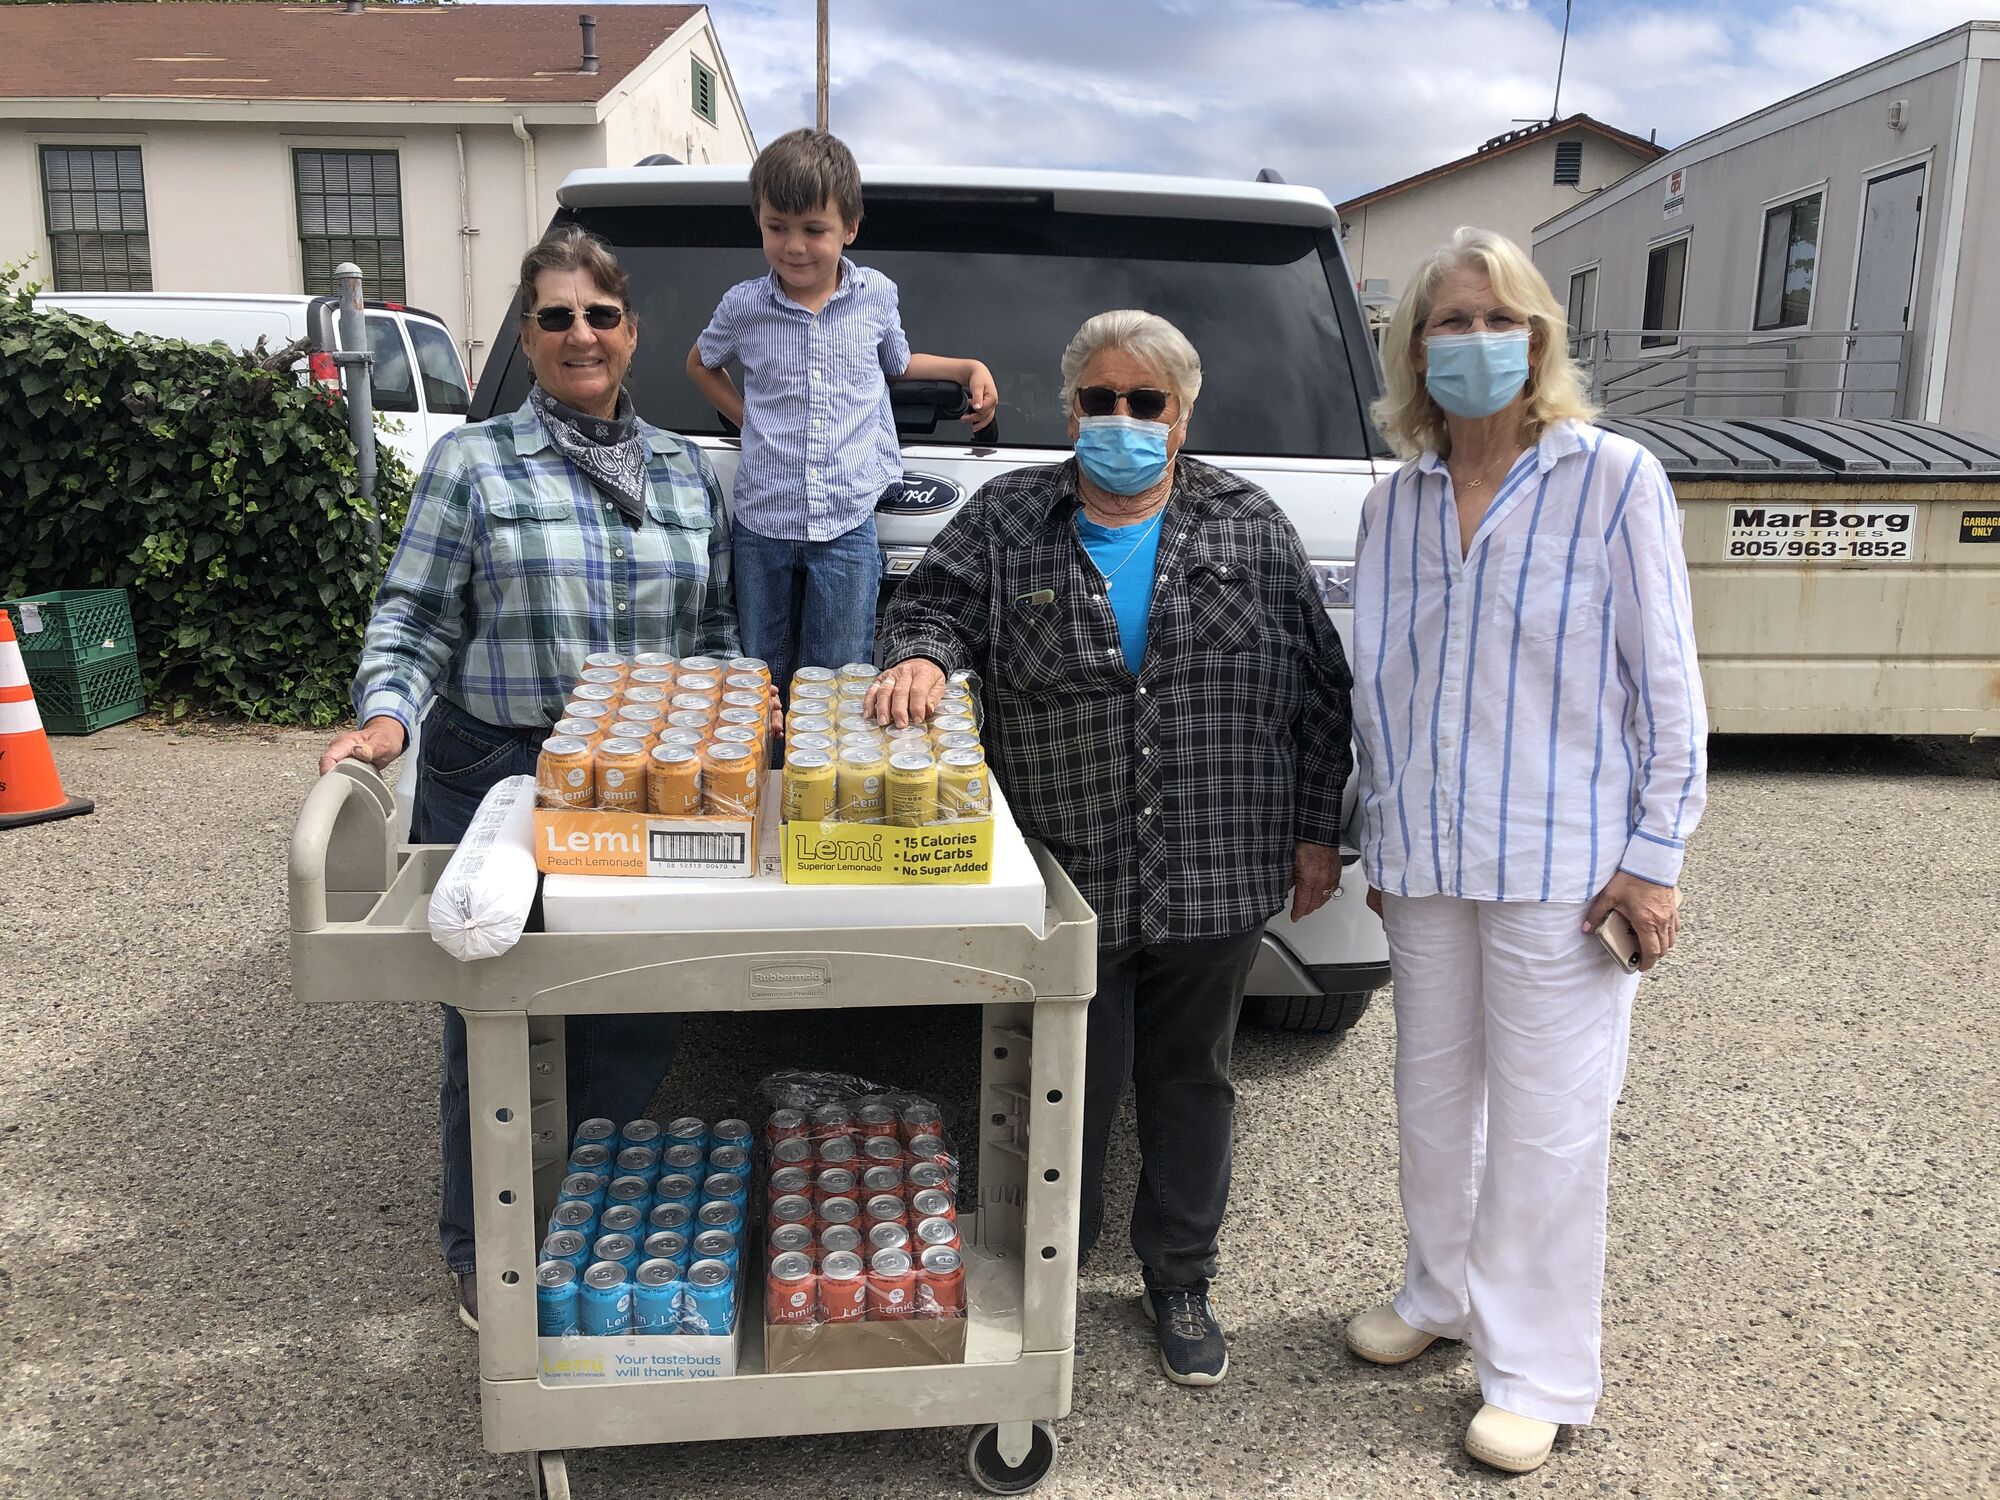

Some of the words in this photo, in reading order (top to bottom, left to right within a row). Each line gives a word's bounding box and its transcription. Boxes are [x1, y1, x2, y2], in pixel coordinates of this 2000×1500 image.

[1733, 509, 1910, 532] MarBorg
[1963, 517, 2000, 526] GARBAG
[1971, 527, 1993, 536] ONLY
[1730, 541, 1907, 557] 805/963-1852
[545, 823, 641, 853] Lemi
[904, 837, 918, 848] 15
[921, 833, 977, 846] Calories
[796, 834, 882, 861] Lemi
[903, 850, 931, 862] Low
[934, 848, 973, 860] Carbs
[547, 857, 582, 866] Peach
[585, 858, 643, 868] Lemonade
[797, 862, 835, 871] Superior
[837, 863, 882, 871] Lemonade
[902, 866, 918, 876] No
[920, 864, 952, 876] Sugar
[953, 862, 988, 873] Added
[543, 1355, 604, 1372] Lemi
[615, 1355, 647, 1365] Your
[651, 1355, 721, 1366] tastebuds
[615, 1367, 640, 1377] will
[644, 1367, 685, 1377] thank
[689, 1369, 718, 1379] you.
